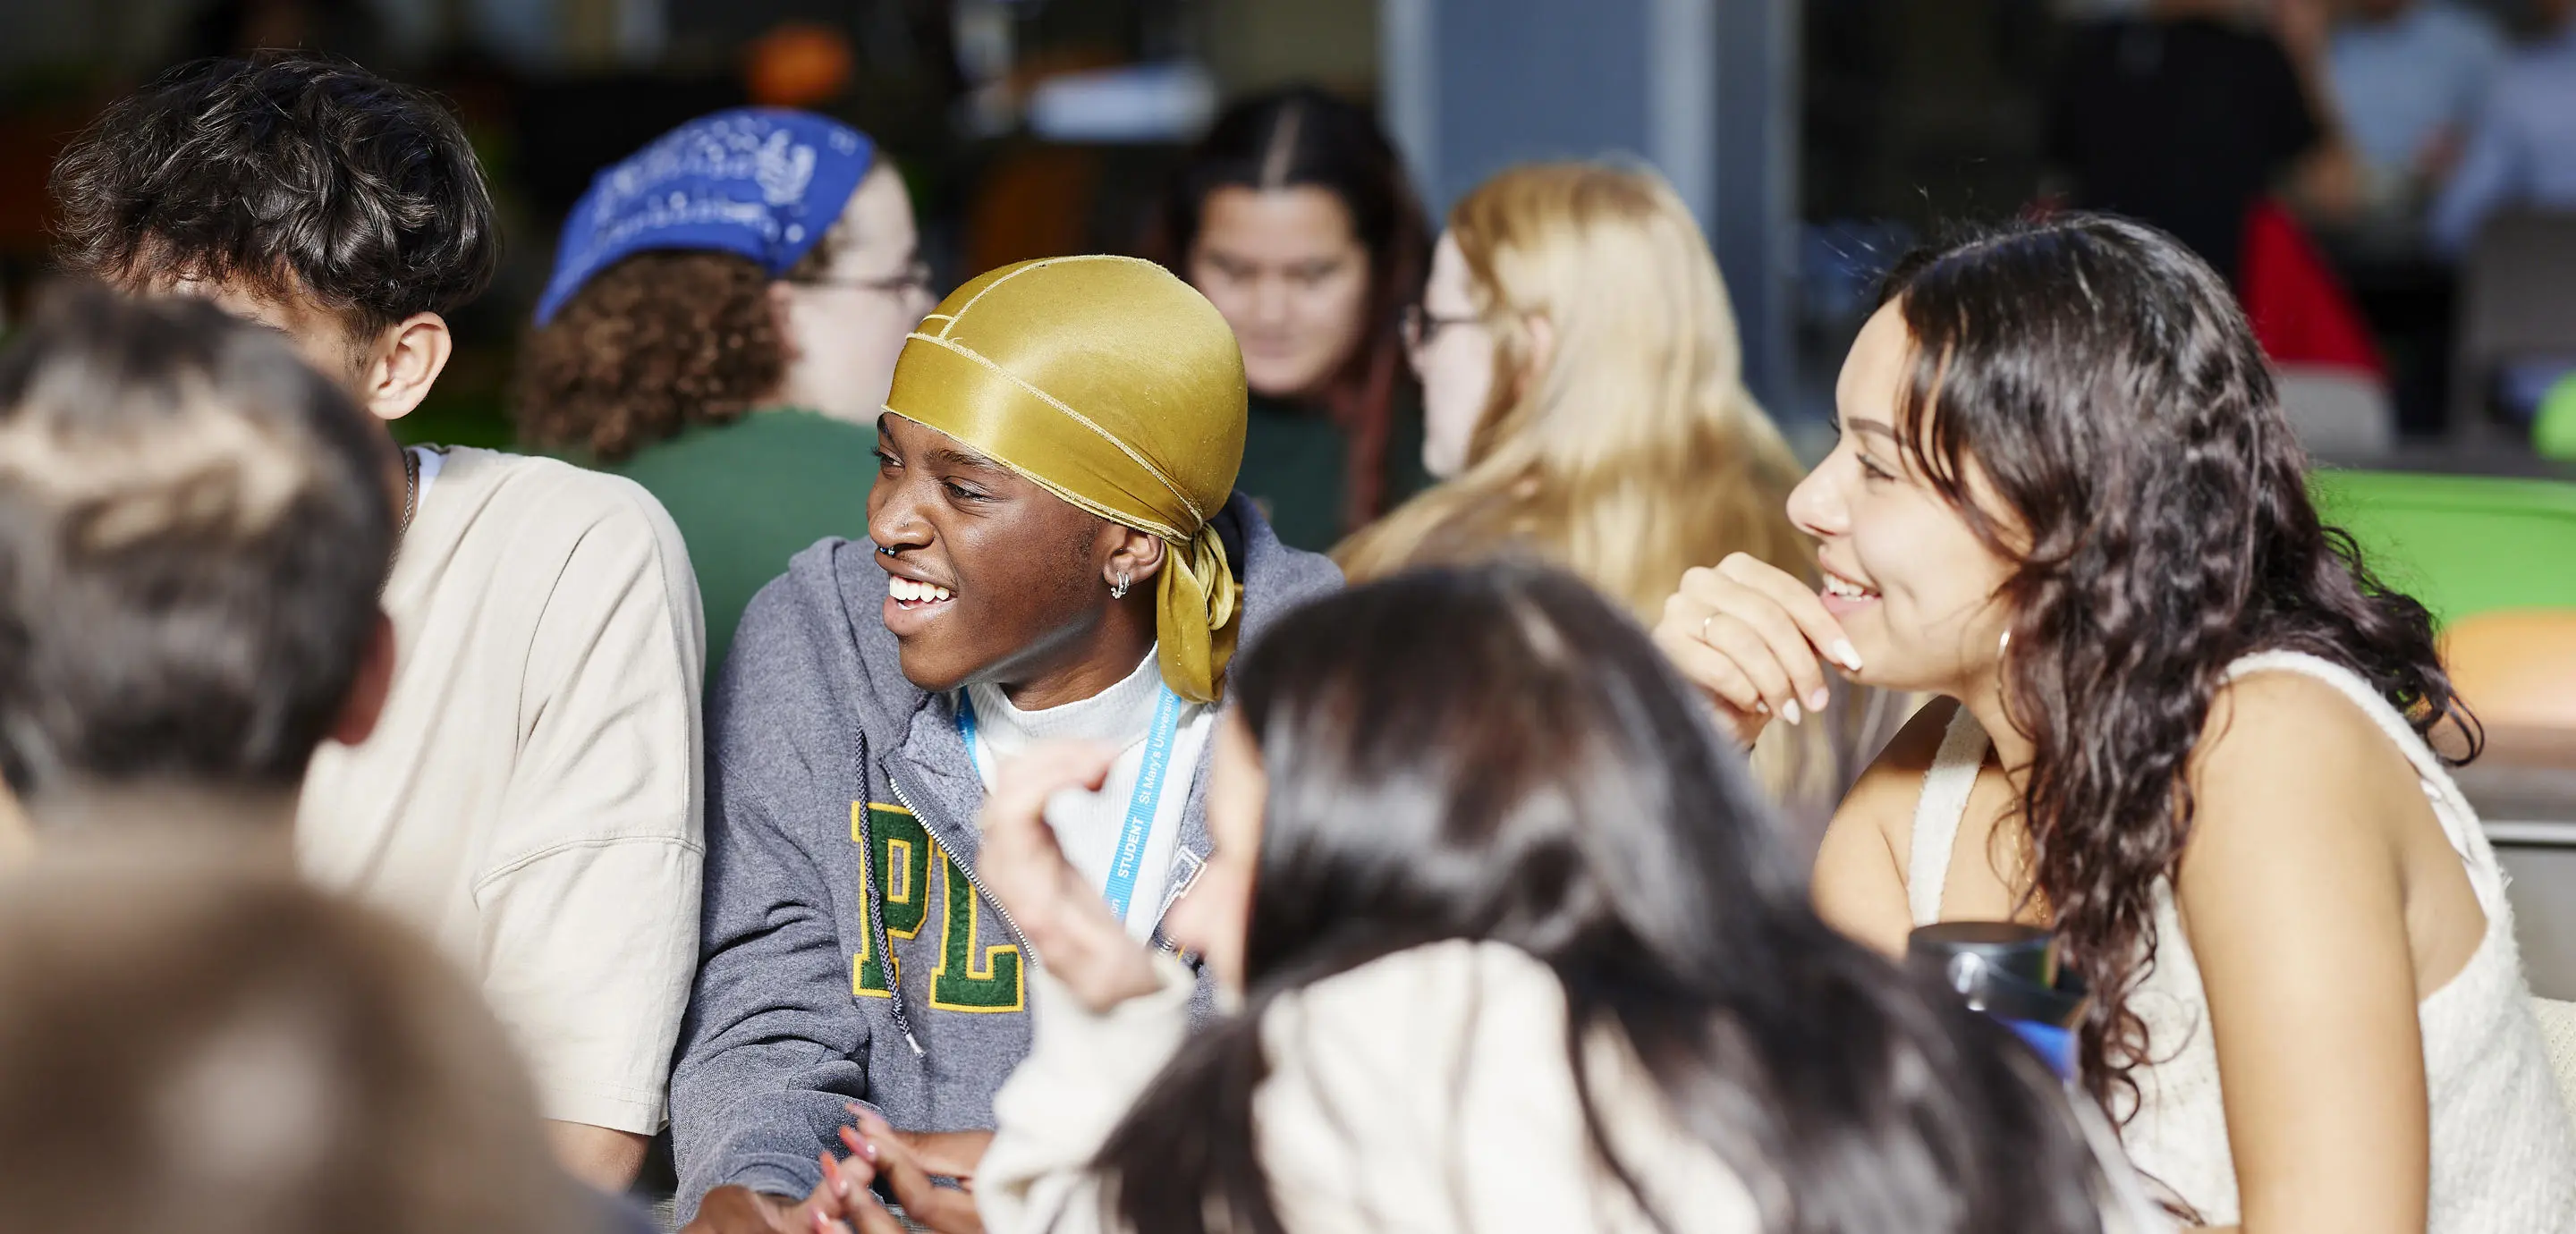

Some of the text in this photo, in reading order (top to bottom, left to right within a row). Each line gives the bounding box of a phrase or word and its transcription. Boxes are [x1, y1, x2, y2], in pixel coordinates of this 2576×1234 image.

[1153, 692, 1175, 748] University
[1144, 751, 1162, 786] Mary's
[1139, 788, 1152, 804] St
[1117, 816, 1144, 878] STUDENT
